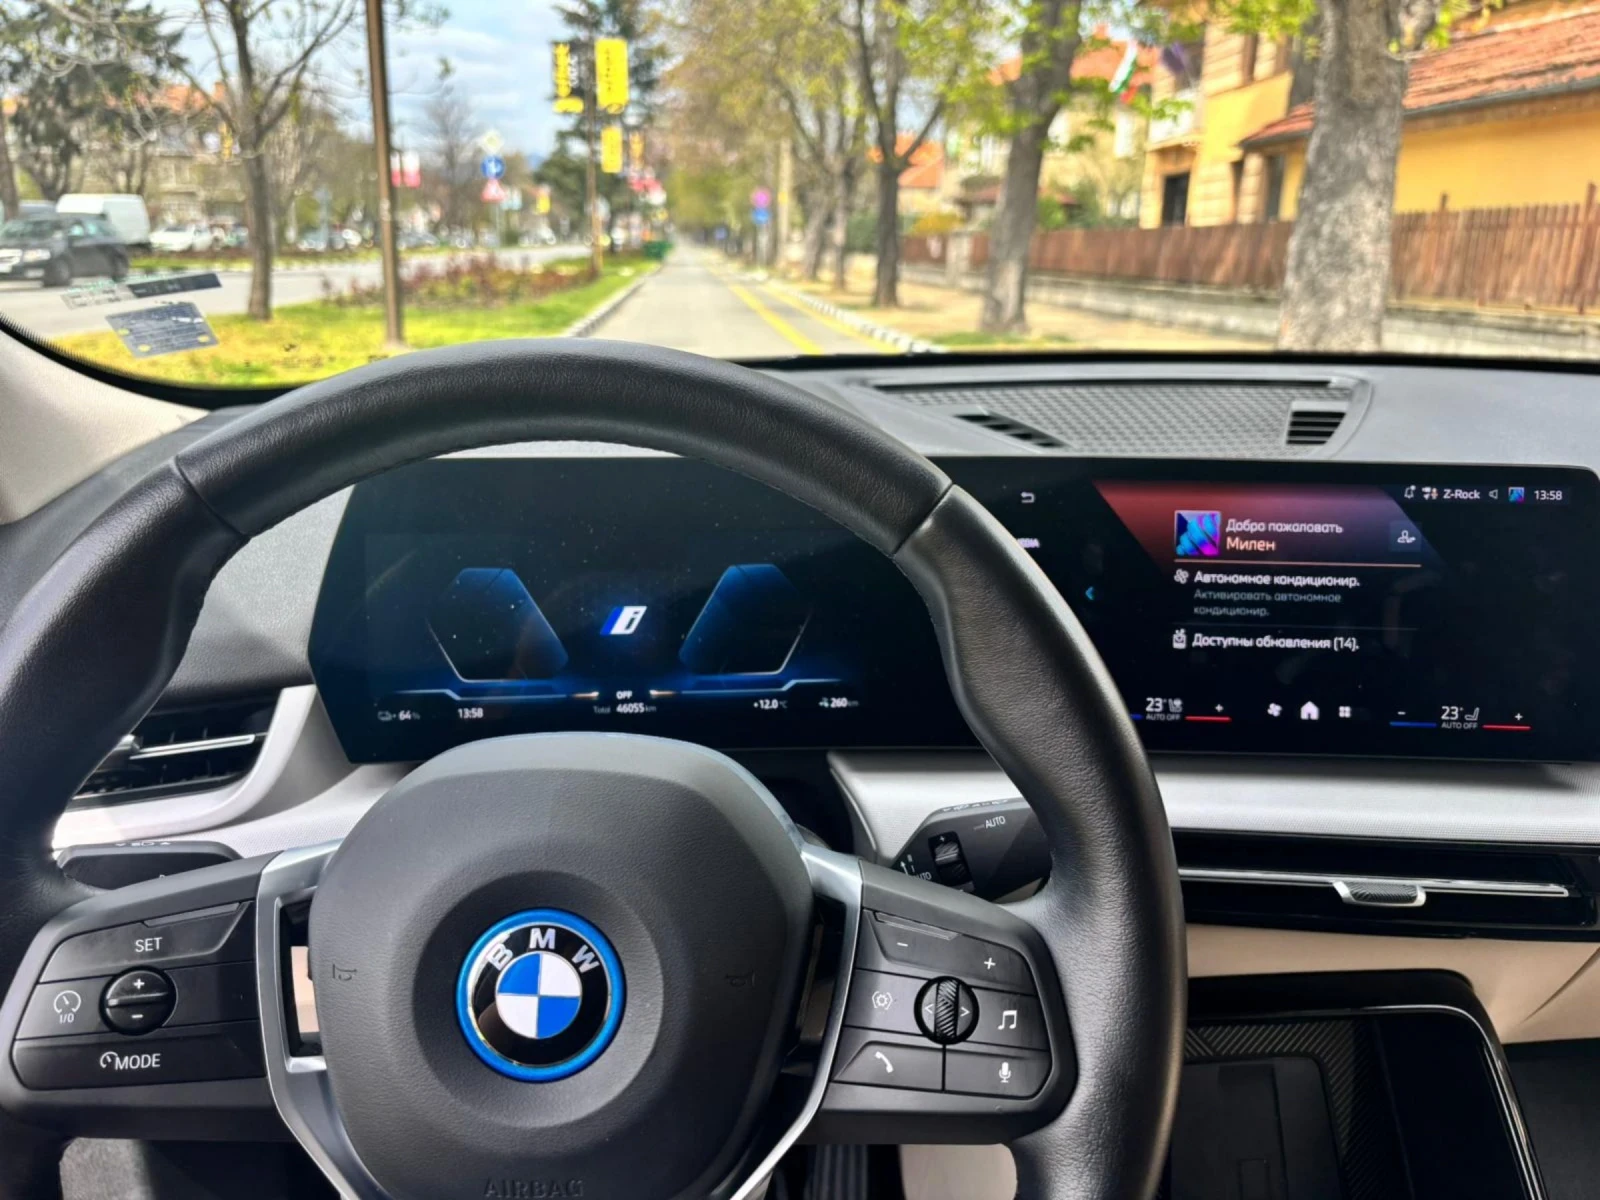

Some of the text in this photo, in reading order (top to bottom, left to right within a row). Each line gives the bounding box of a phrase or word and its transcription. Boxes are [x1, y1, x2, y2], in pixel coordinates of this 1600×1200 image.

[1443, 488, 1481, 500] Z-Rock
[1534, 490, 1563, 501] 13:58
[1226, 519, 1344, 534] Добро пожаловать
[1226, 537, 1276, 551] Милен
[1194, 572, 1361, 588] Автономное кондиционир.
[1194, 589, 1342, 603] Активировать автономное
[1192, 634, 1360, 651] Доступны обновления (14).
[457, 707, 484, 719] 13:58
[1441, 721, 1478, 730] AUTO OFF
[985, 815, 1006, 829] AUTO
[134, 936, 162, 953] SET
[486, 927, 600, 975] BMW
[114, 1053, 162, 1071] MODE
[483, 1177, 584, 1199] AIRBAG
